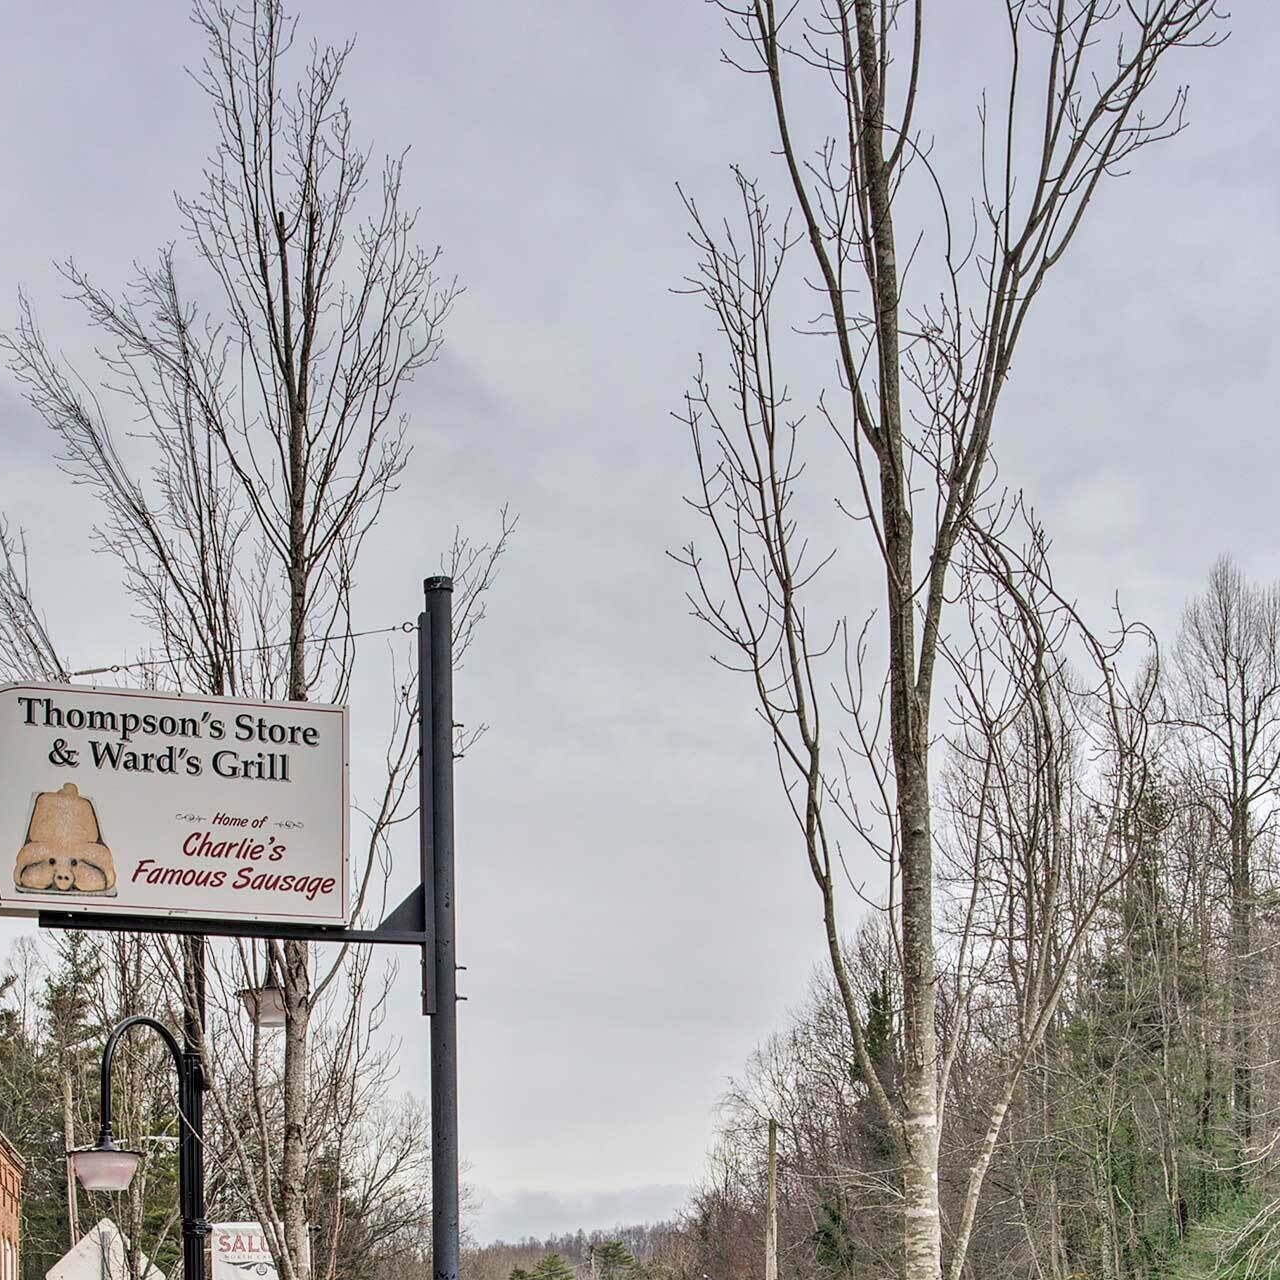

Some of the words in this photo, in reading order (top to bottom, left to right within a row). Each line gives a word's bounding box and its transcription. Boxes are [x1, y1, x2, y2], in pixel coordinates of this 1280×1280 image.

[17, 696, 224, 741] Thompson's
[234, 713, 320, 746] Store
[48, 738, 80, 768] &
[89, 740, 202, 777] Ward's
[211, 749, 291, 783] Grill
[212, 812, 248, 828] Home
[251, 815, 268, 829] of
[182, 831, 286, 862] Charlie's
[131, 859, 226, 889] Famous
[232, 868, 336, 900] Sausage
